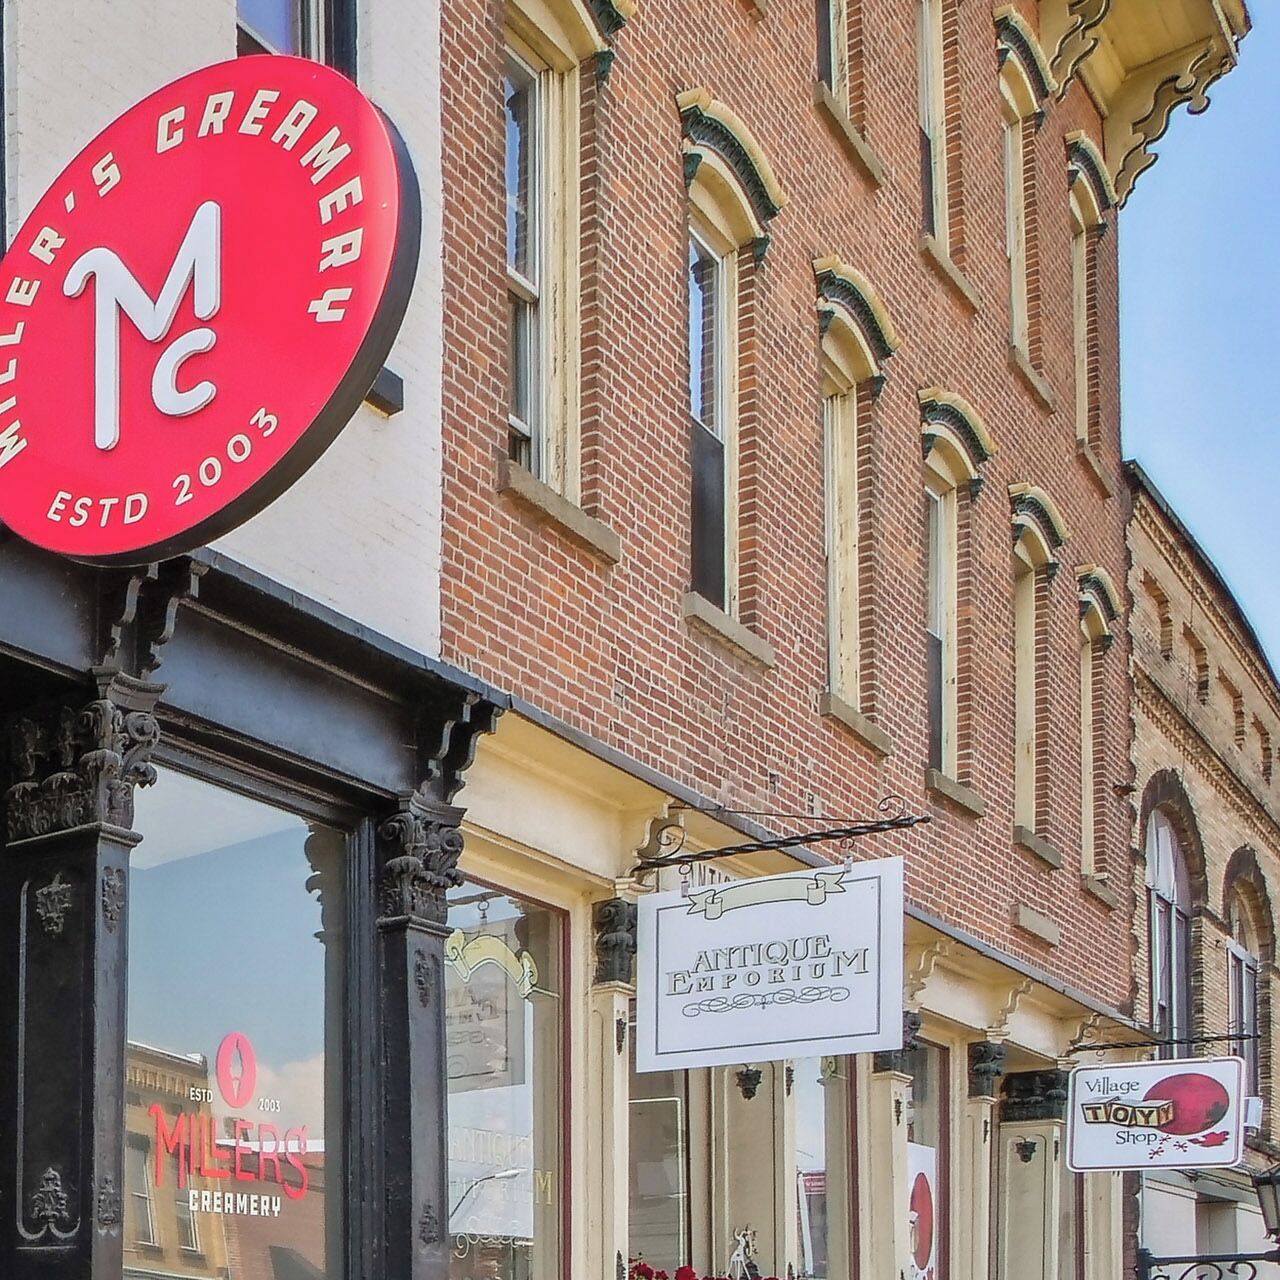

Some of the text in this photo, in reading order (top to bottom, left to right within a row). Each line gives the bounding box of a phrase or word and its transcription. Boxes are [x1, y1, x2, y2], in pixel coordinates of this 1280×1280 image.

[154, 87, 365, 324] CREAMERY
[46, 406, 280, 529] ESTD 2003
[664, 946, 870, 997] EMPORIUM
[690, 933, 833, 975] ANTIQUE
[189, 1087, 281, 1113] ESTD 2003
[1085, 1077, 1140, 1095] Village
[148, 1102, 310, 1201] MILLERS
[1115, 1130, 1159, 1146] Shop
[188, 1189, 282, 1217] CREAMERY
